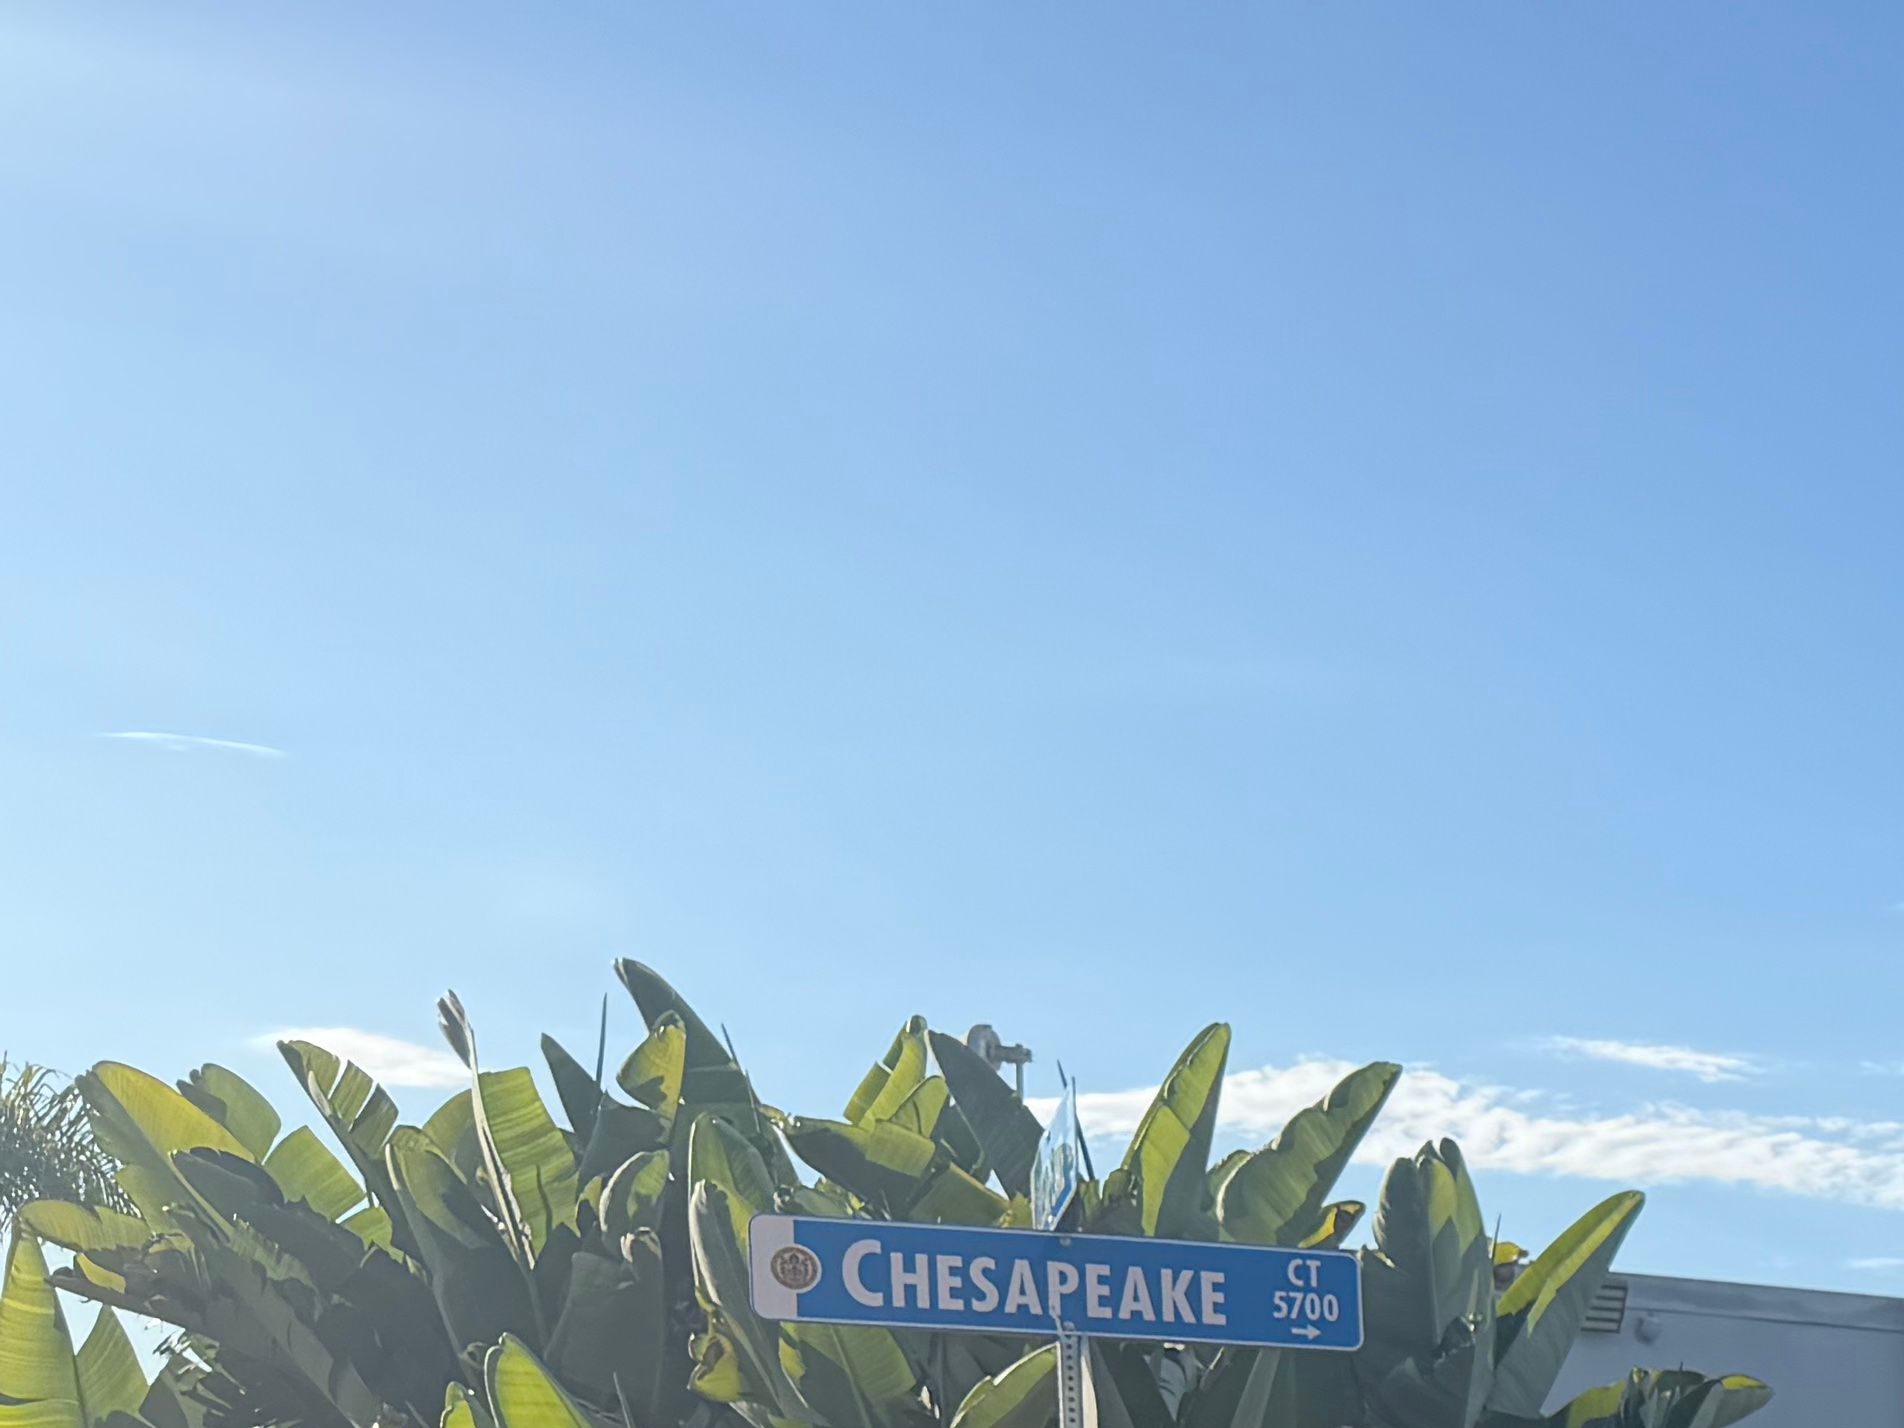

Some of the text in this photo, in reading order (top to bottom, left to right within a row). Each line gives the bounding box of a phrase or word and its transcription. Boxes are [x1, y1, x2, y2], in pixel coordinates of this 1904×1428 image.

[841, 1239, 1226, 1325] CHESAPEAKE
[1287, 1259, 1320, 1288] CT
[1271, 1291, 1339, 1322] 5700
